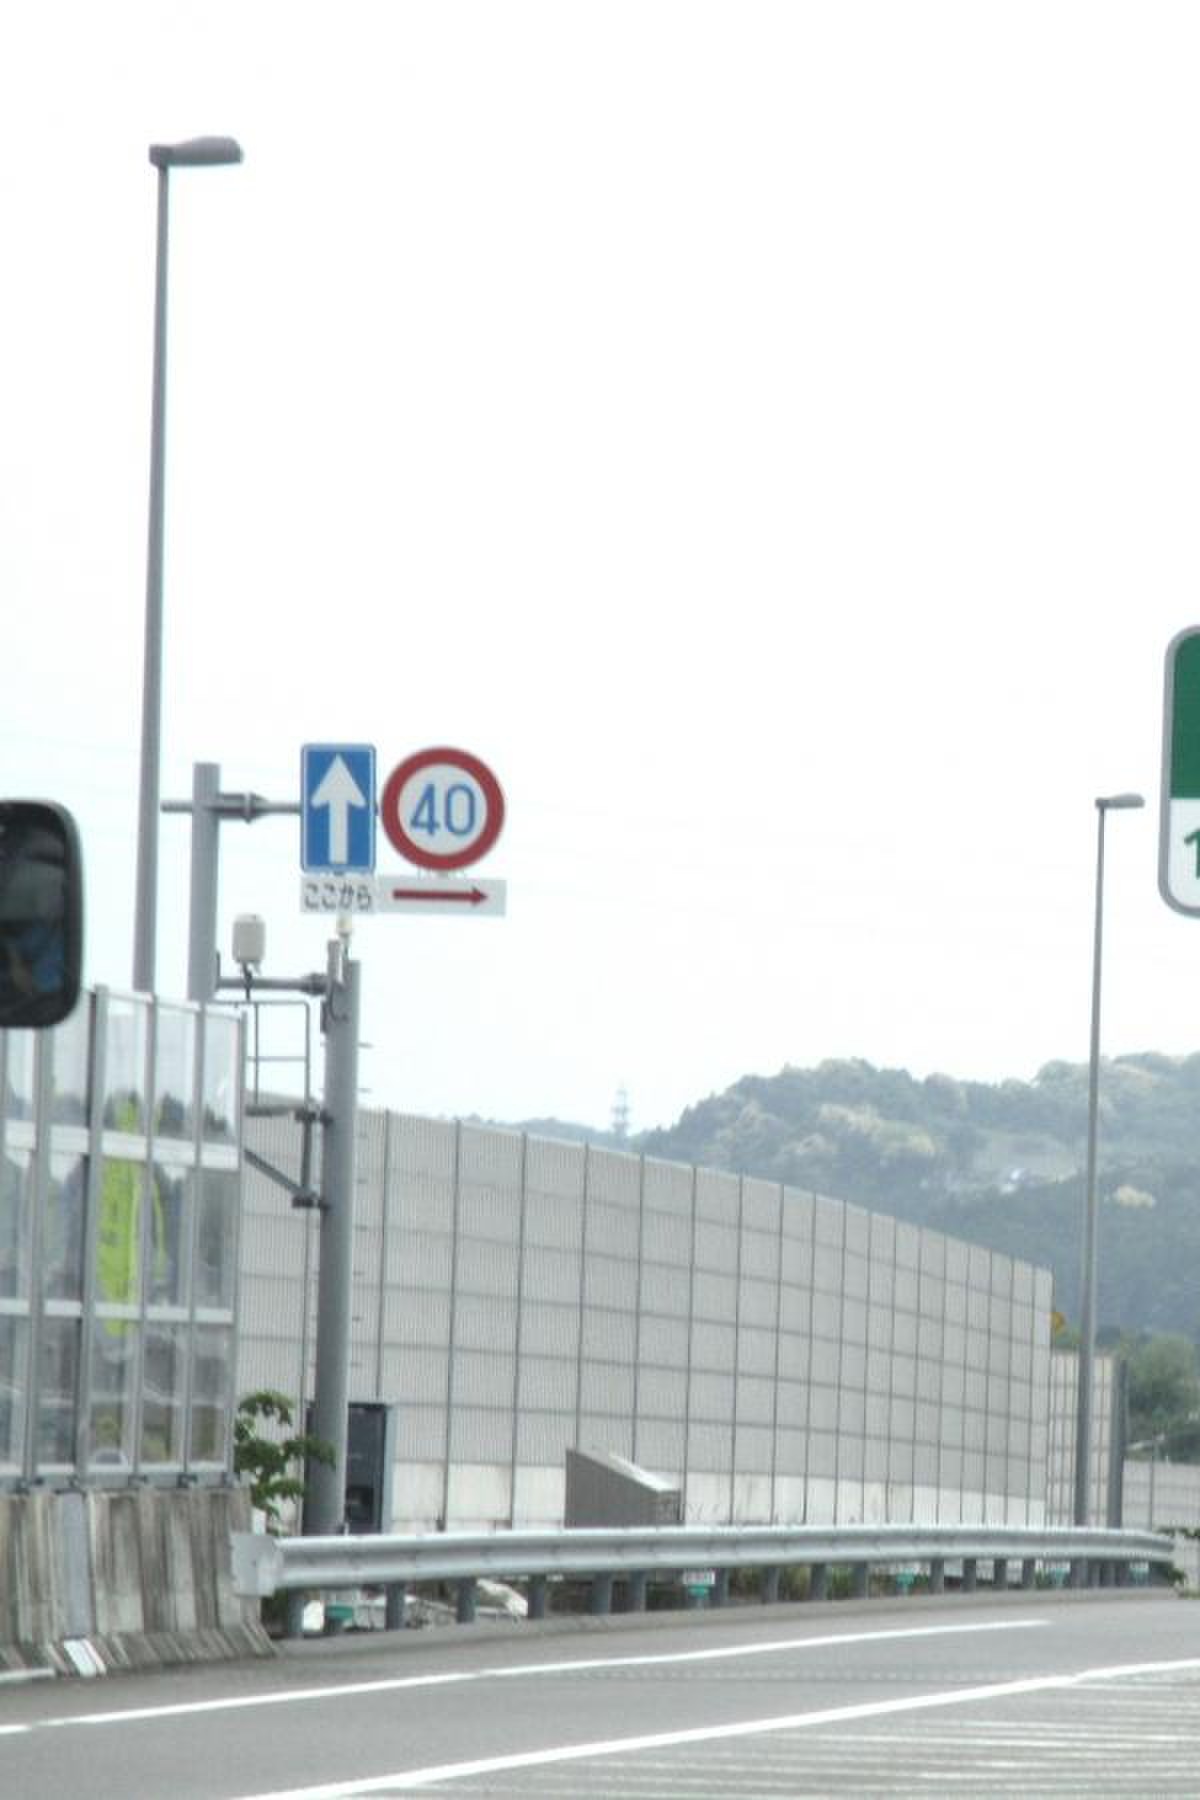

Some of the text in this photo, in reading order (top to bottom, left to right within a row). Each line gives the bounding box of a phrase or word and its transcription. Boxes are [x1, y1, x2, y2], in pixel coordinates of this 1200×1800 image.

[410, 783, 475, 836] 40
[304, 882, 372, 911] ここから
